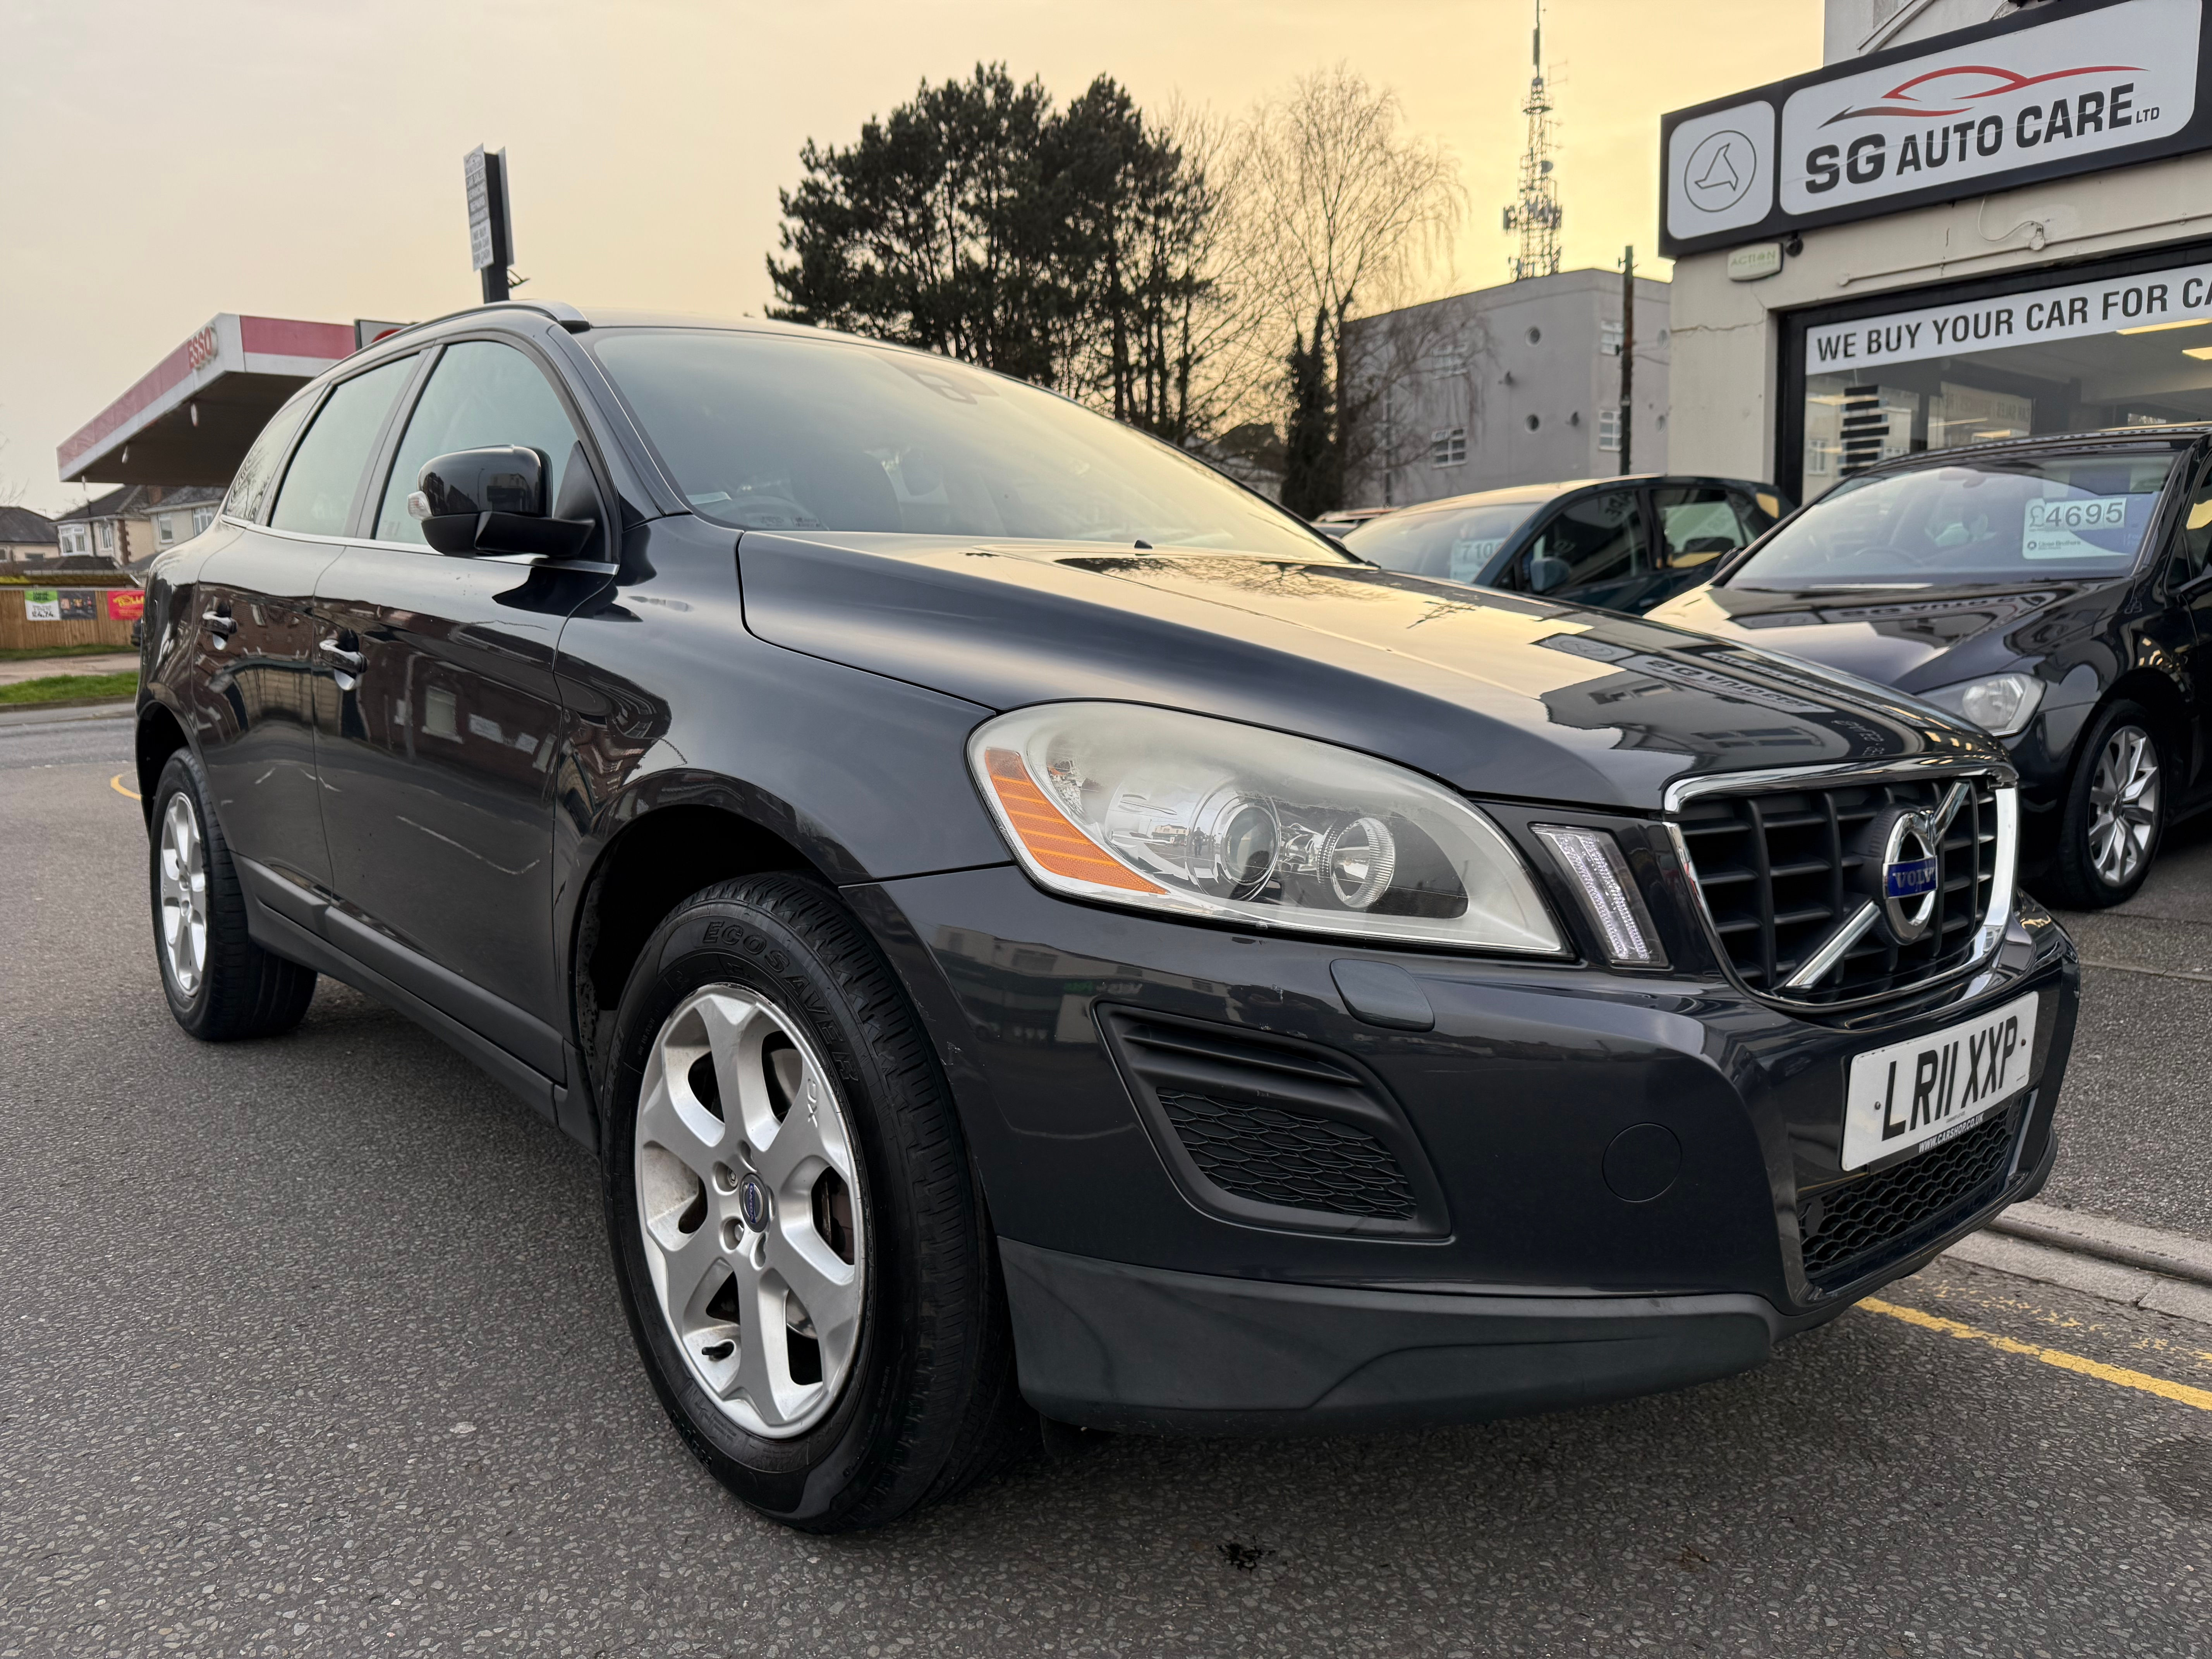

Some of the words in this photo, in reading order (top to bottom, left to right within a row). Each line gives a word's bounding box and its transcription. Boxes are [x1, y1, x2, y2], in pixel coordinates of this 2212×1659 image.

[1805, 134, 1886, 194] SG
[1896, 114, 2002, 176] AUTO
[2016, 82, 2134, 149] CARE
[2136, 106, 2160, 124] LTD
[1817, 332, 1856, 361] WE
[1867, 322, 1922, 354] BUY
[1932, 308, 2014, 344] YOUR
[2026, 296, 2088, 331] CAR
[2102, 283, 2168, 320] FOR
[2029, 502, 2123, 527] £4695
[703, 921, 859, 1082] ECOSAVER
[1882, 1041, 1959, 1141] LR11
[1961, 1015, 2018, 1109] XXP
[1918, 1113, 1984, 1153] WWW.CARSHOP.CO.UK
